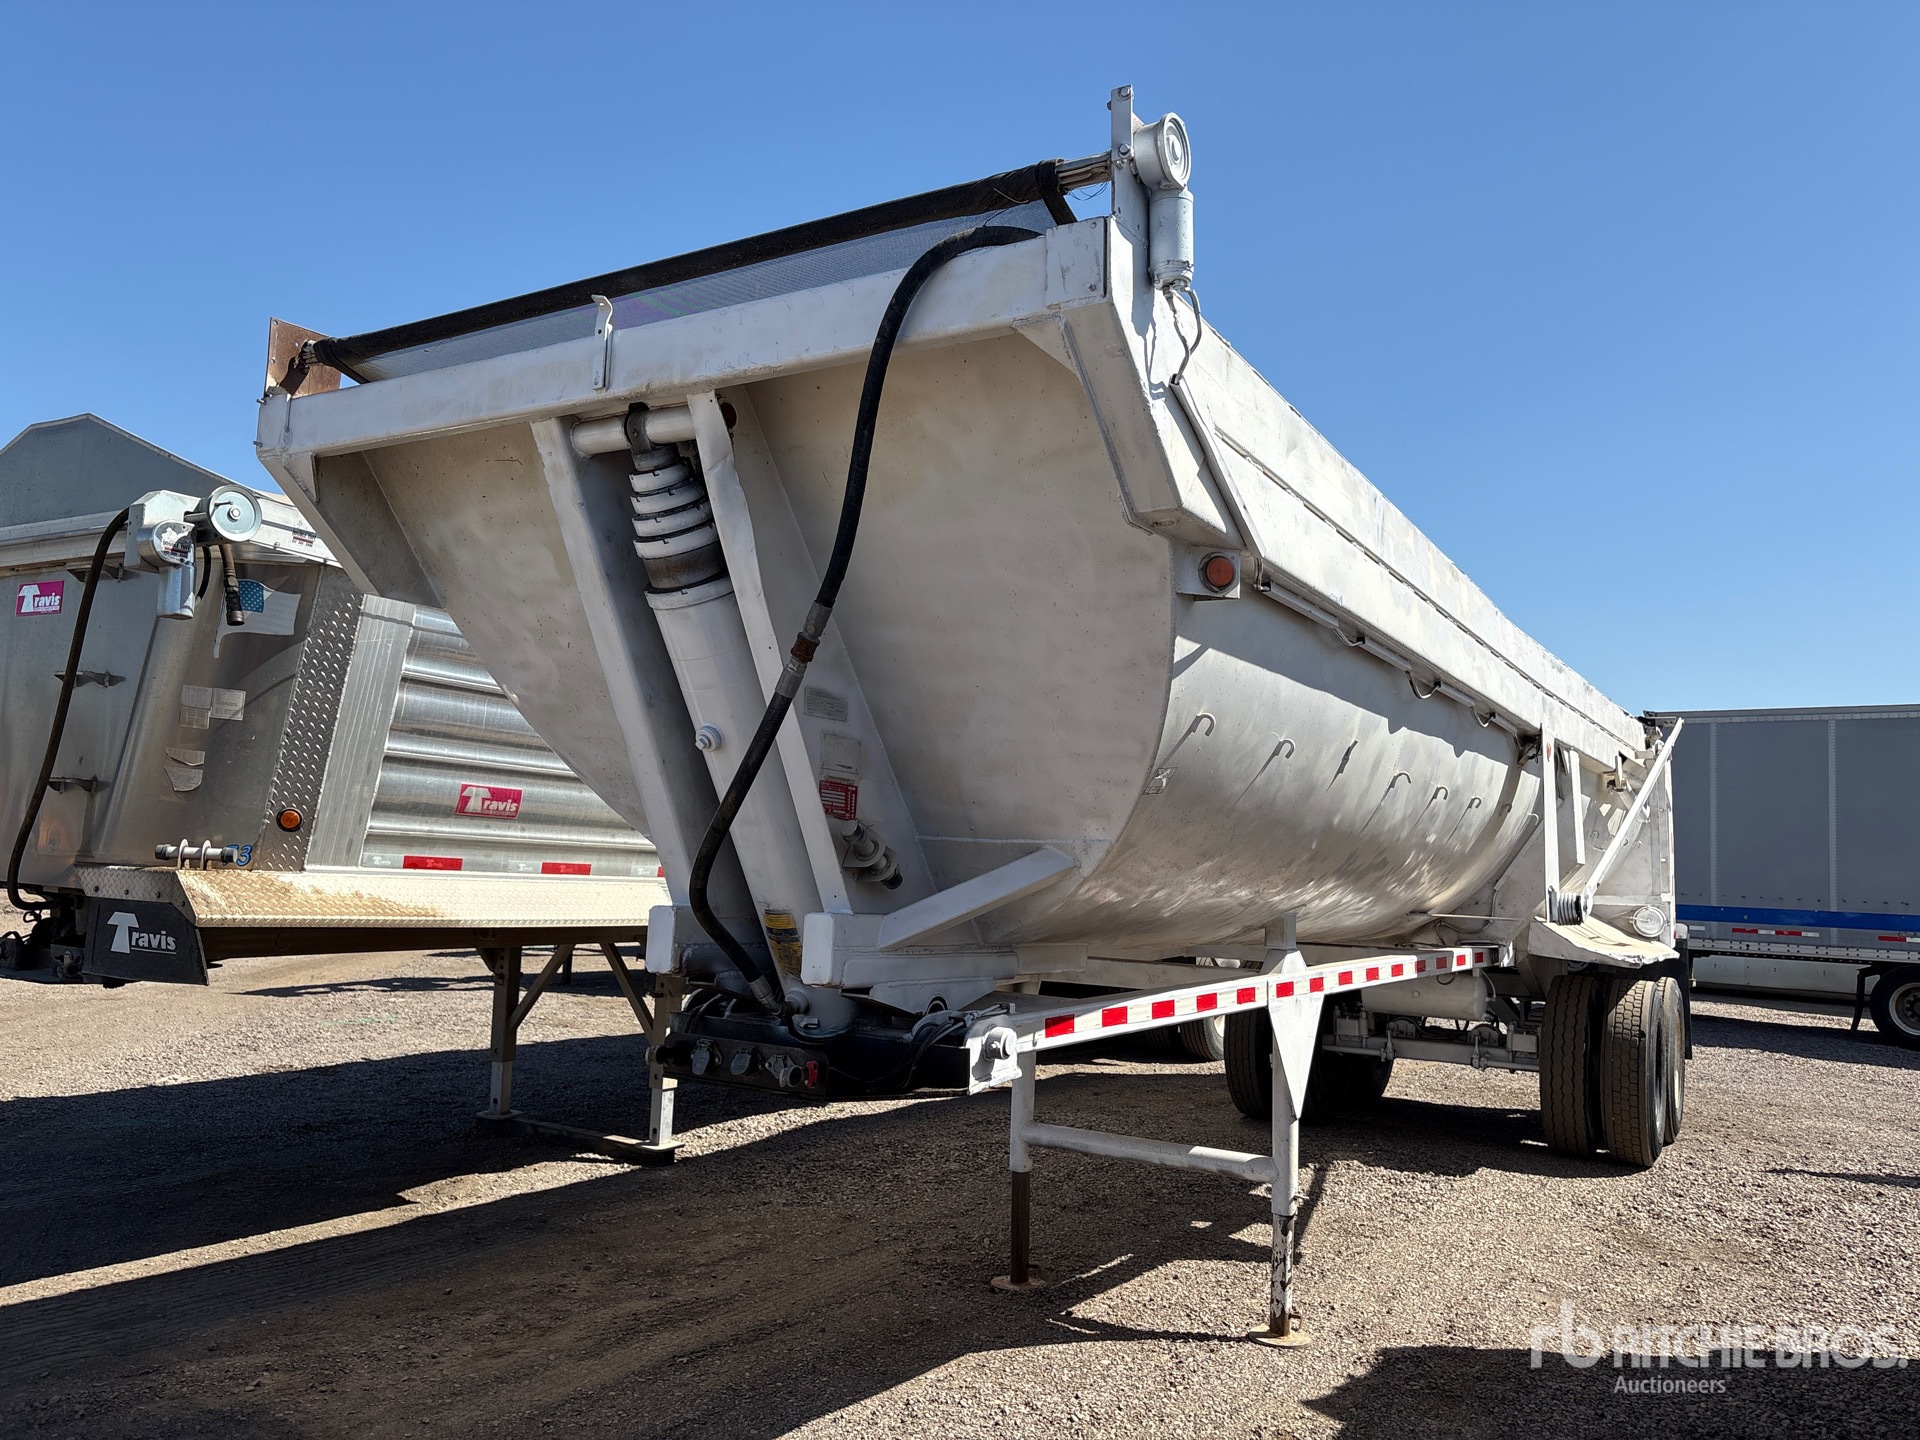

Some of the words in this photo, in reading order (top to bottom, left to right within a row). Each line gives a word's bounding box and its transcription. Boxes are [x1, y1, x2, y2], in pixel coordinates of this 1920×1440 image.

[19, 584, 61, 612] Travis
[461, 787, 518, 812] Travis
[107, 911, 176, 953] Travis
